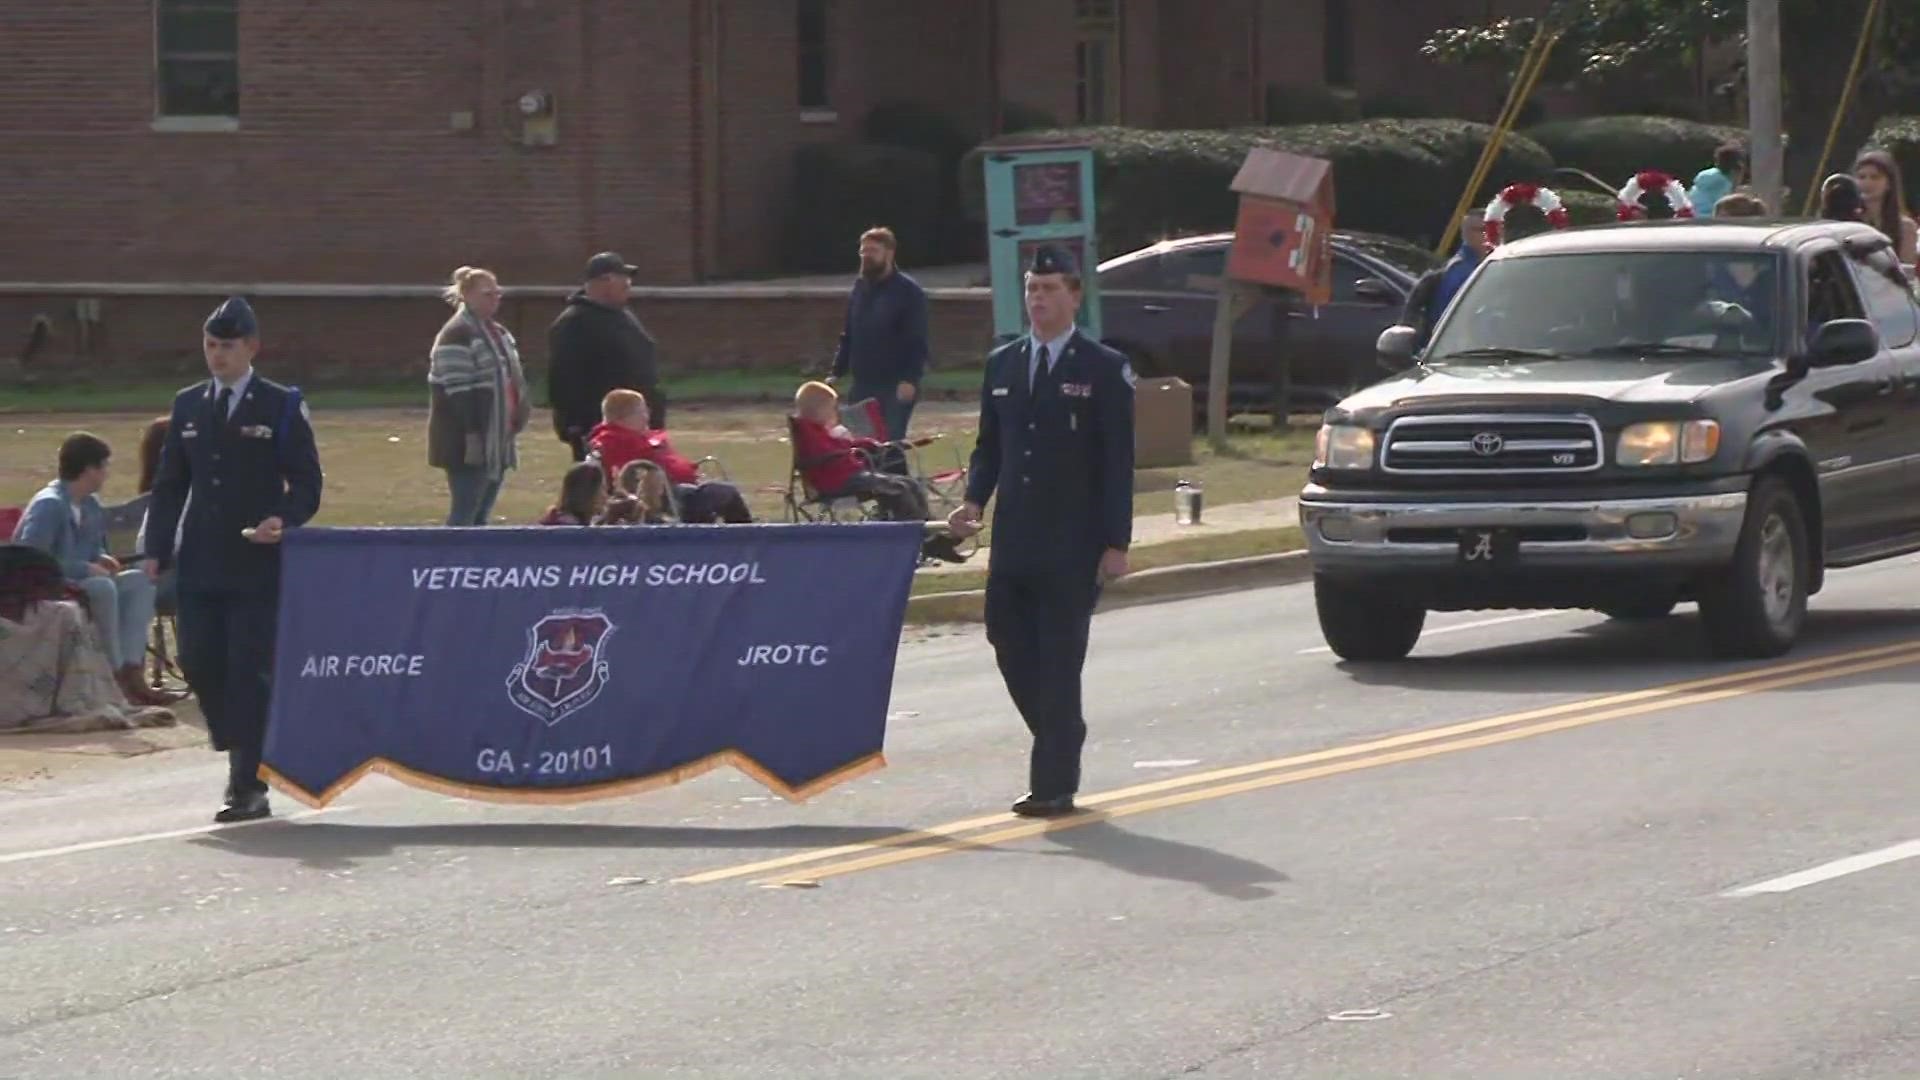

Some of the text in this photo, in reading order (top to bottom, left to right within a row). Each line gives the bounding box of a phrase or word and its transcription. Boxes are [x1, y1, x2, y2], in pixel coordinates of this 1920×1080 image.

[1464, 533, 1493, 561] A
[411, 562, 766, 590] VETERANS HIGH SCHOOL
[300, 653, 425, 677] AIR FORCE
[737, 644, 829, 666] JROTC
[476, 748, 515, 773] GA
[538, 743, 613, 774] 20101
